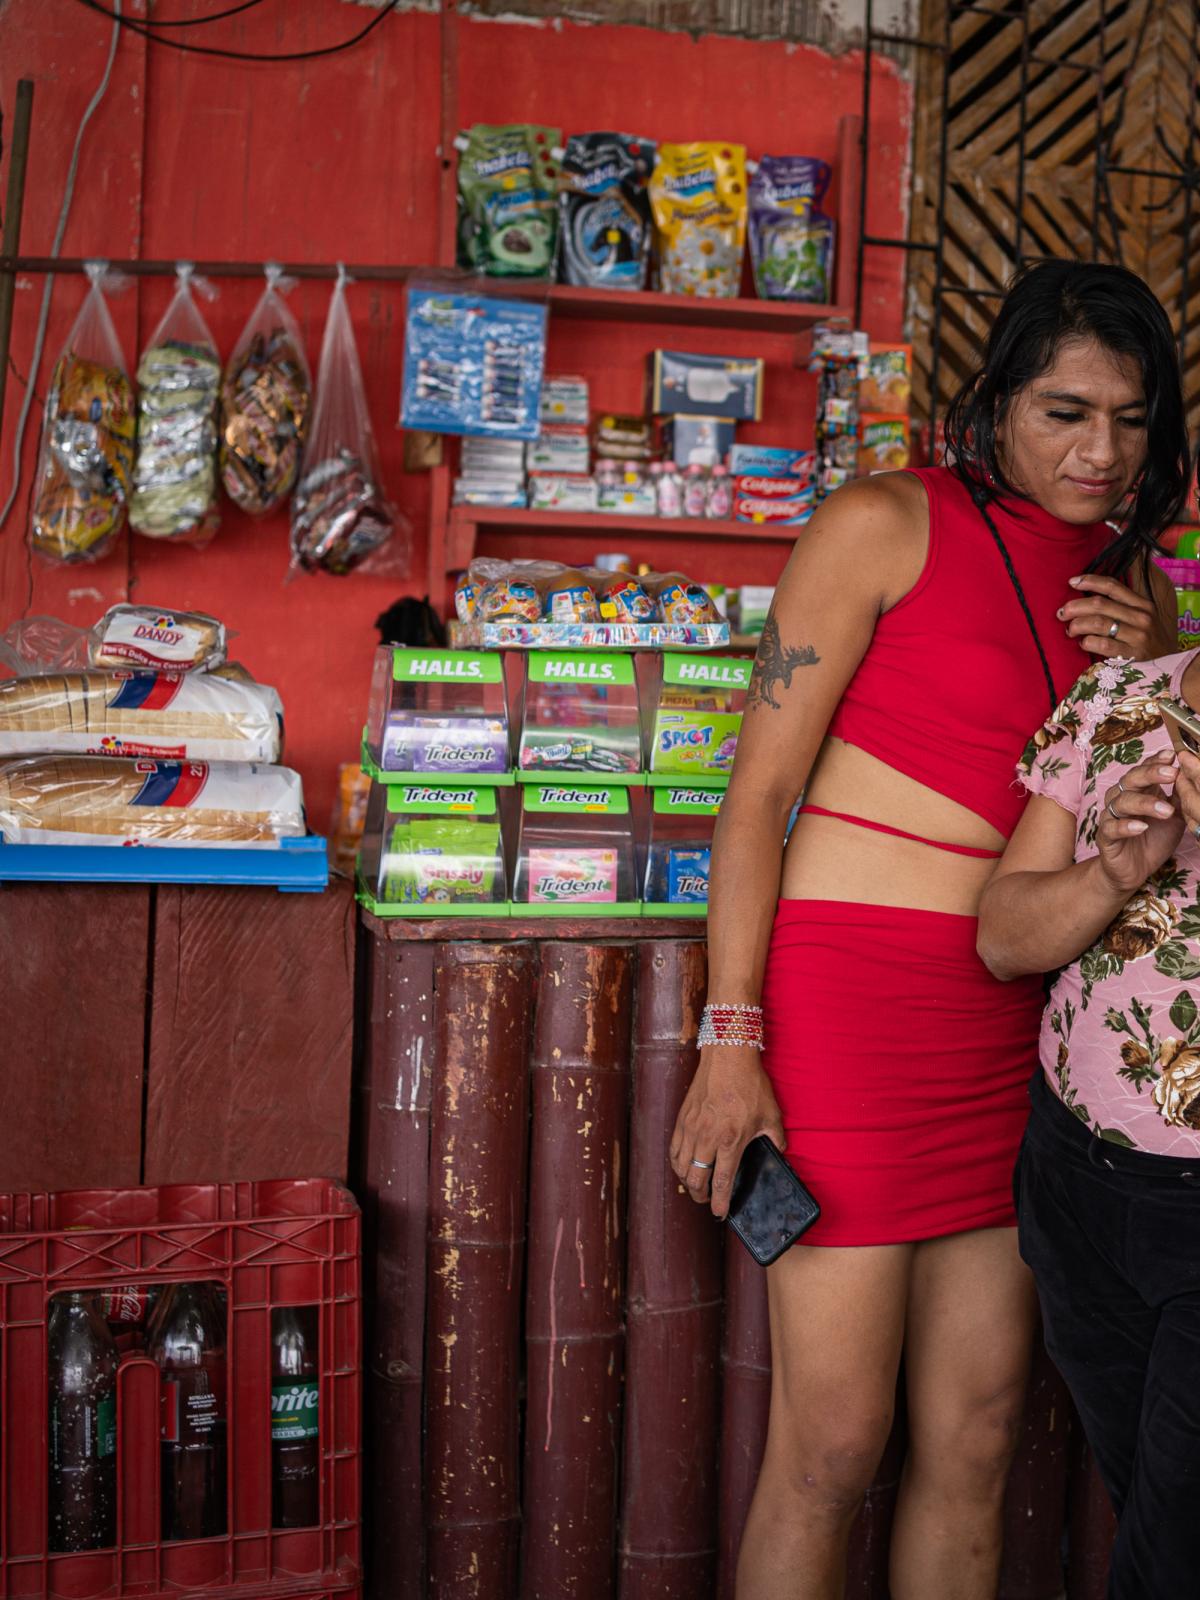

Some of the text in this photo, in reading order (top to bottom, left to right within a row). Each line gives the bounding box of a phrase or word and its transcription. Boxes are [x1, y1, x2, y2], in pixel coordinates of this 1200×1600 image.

[740, 479, 799, 496] Colgate
[740, 499, 800, 515] Colgate
[133, 624, 184, 645] DANDY
[426, 744, 494, 762] Trident
[405, 787, 476, 803] Trident
[540, 787, 609, 804] Trident
[540, 878, 604, 893] Trident
